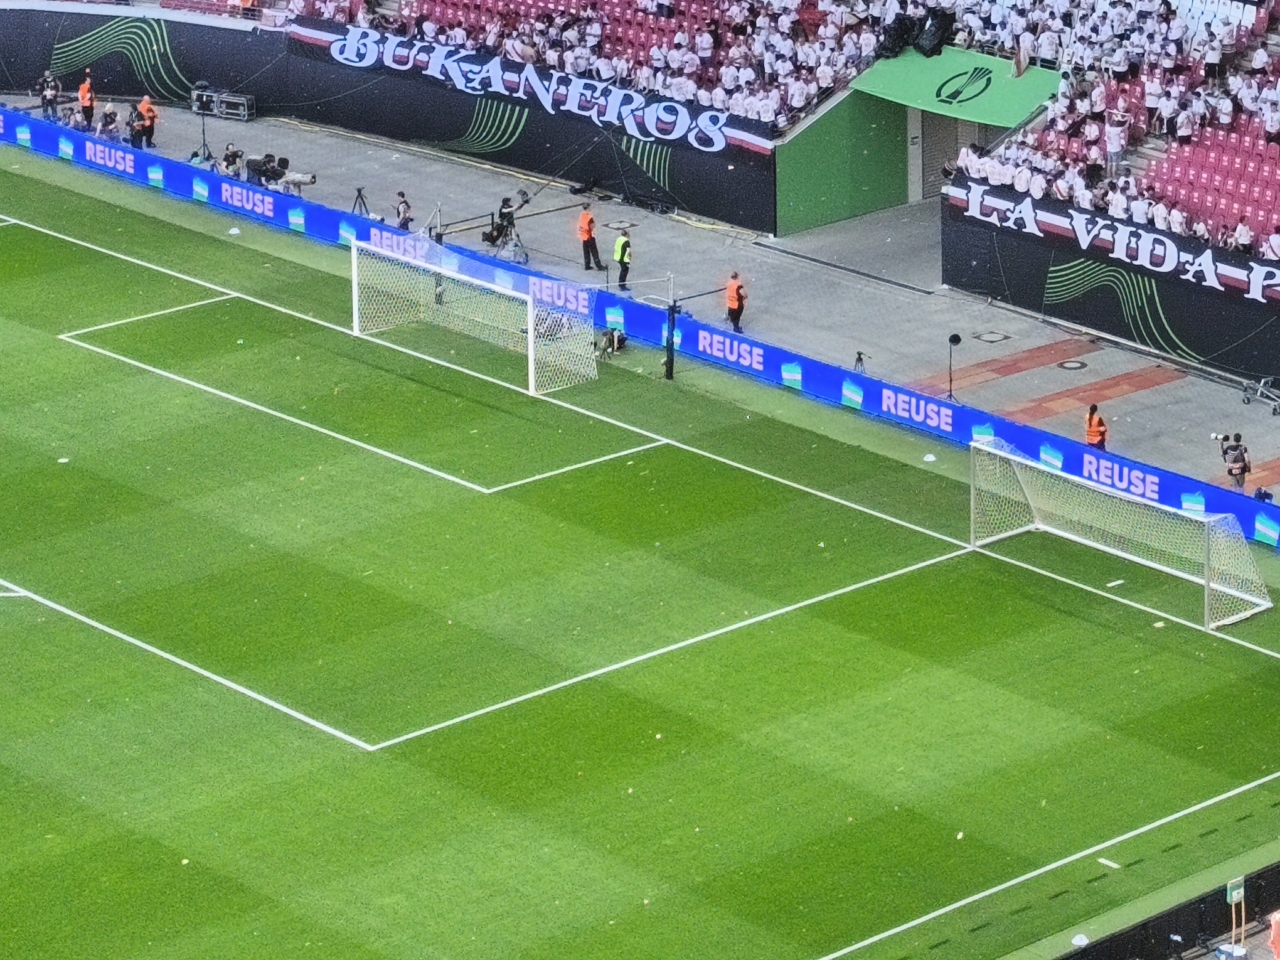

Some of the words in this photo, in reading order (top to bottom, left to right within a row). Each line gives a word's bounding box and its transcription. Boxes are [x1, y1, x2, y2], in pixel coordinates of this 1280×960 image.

[330, 24, 729, 152] BUKANEROS
[85, 142, 135, 174] REUSE
[221, 182, 274, 218] REUSE
[370, 227, 429, 260] REUSE
[964, 182, 1043, 236] LA
[1068, 208, 1224, 291] VIDA
[528, 276, 589, 314] REUSE
[698, 329, 764, 371] REUSE
[881, 388, 953, 432] REUSE
[1082, 453, 1160, 500] REUSE
